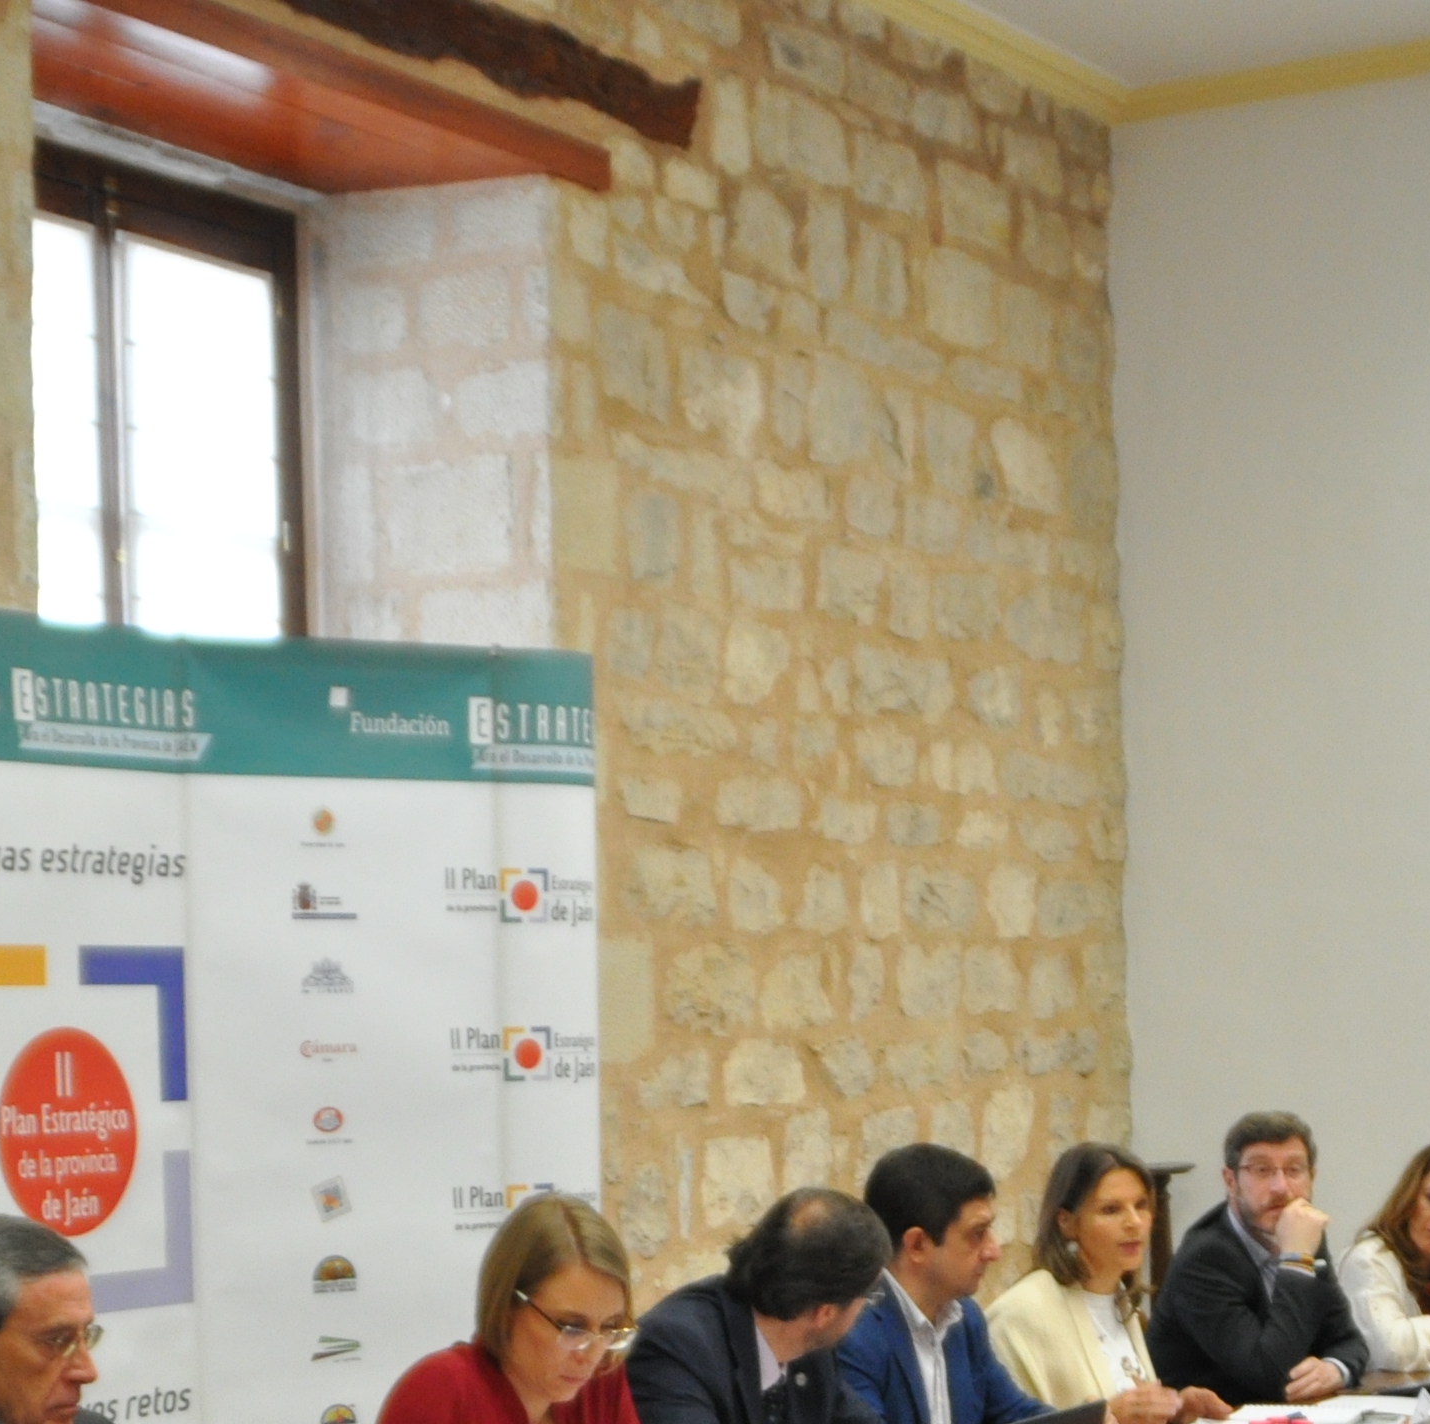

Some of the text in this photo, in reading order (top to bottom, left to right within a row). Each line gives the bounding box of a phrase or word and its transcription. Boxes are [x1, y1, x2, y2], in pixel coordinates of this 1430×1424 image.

[12, 668, 195, 728] ESTRATEGIAS
[350, 697, 591, 744] Fundación ESTRATE
[40, 844, 186, 886] estrategias
[462, 867, 497, 890] Plan
[466, 1026, 501, 1050] Plan
[55, 1051, 73, 1097] II
[1, 1101, 129, 1141] Plan Estratégico
[18, 1148, 118, 1184] de la provincia
[42, 1188, 100, 1227] de Jaén
[470, 1186, 503, 1208] Plan
[125, 1386, 191, 1420] retos
